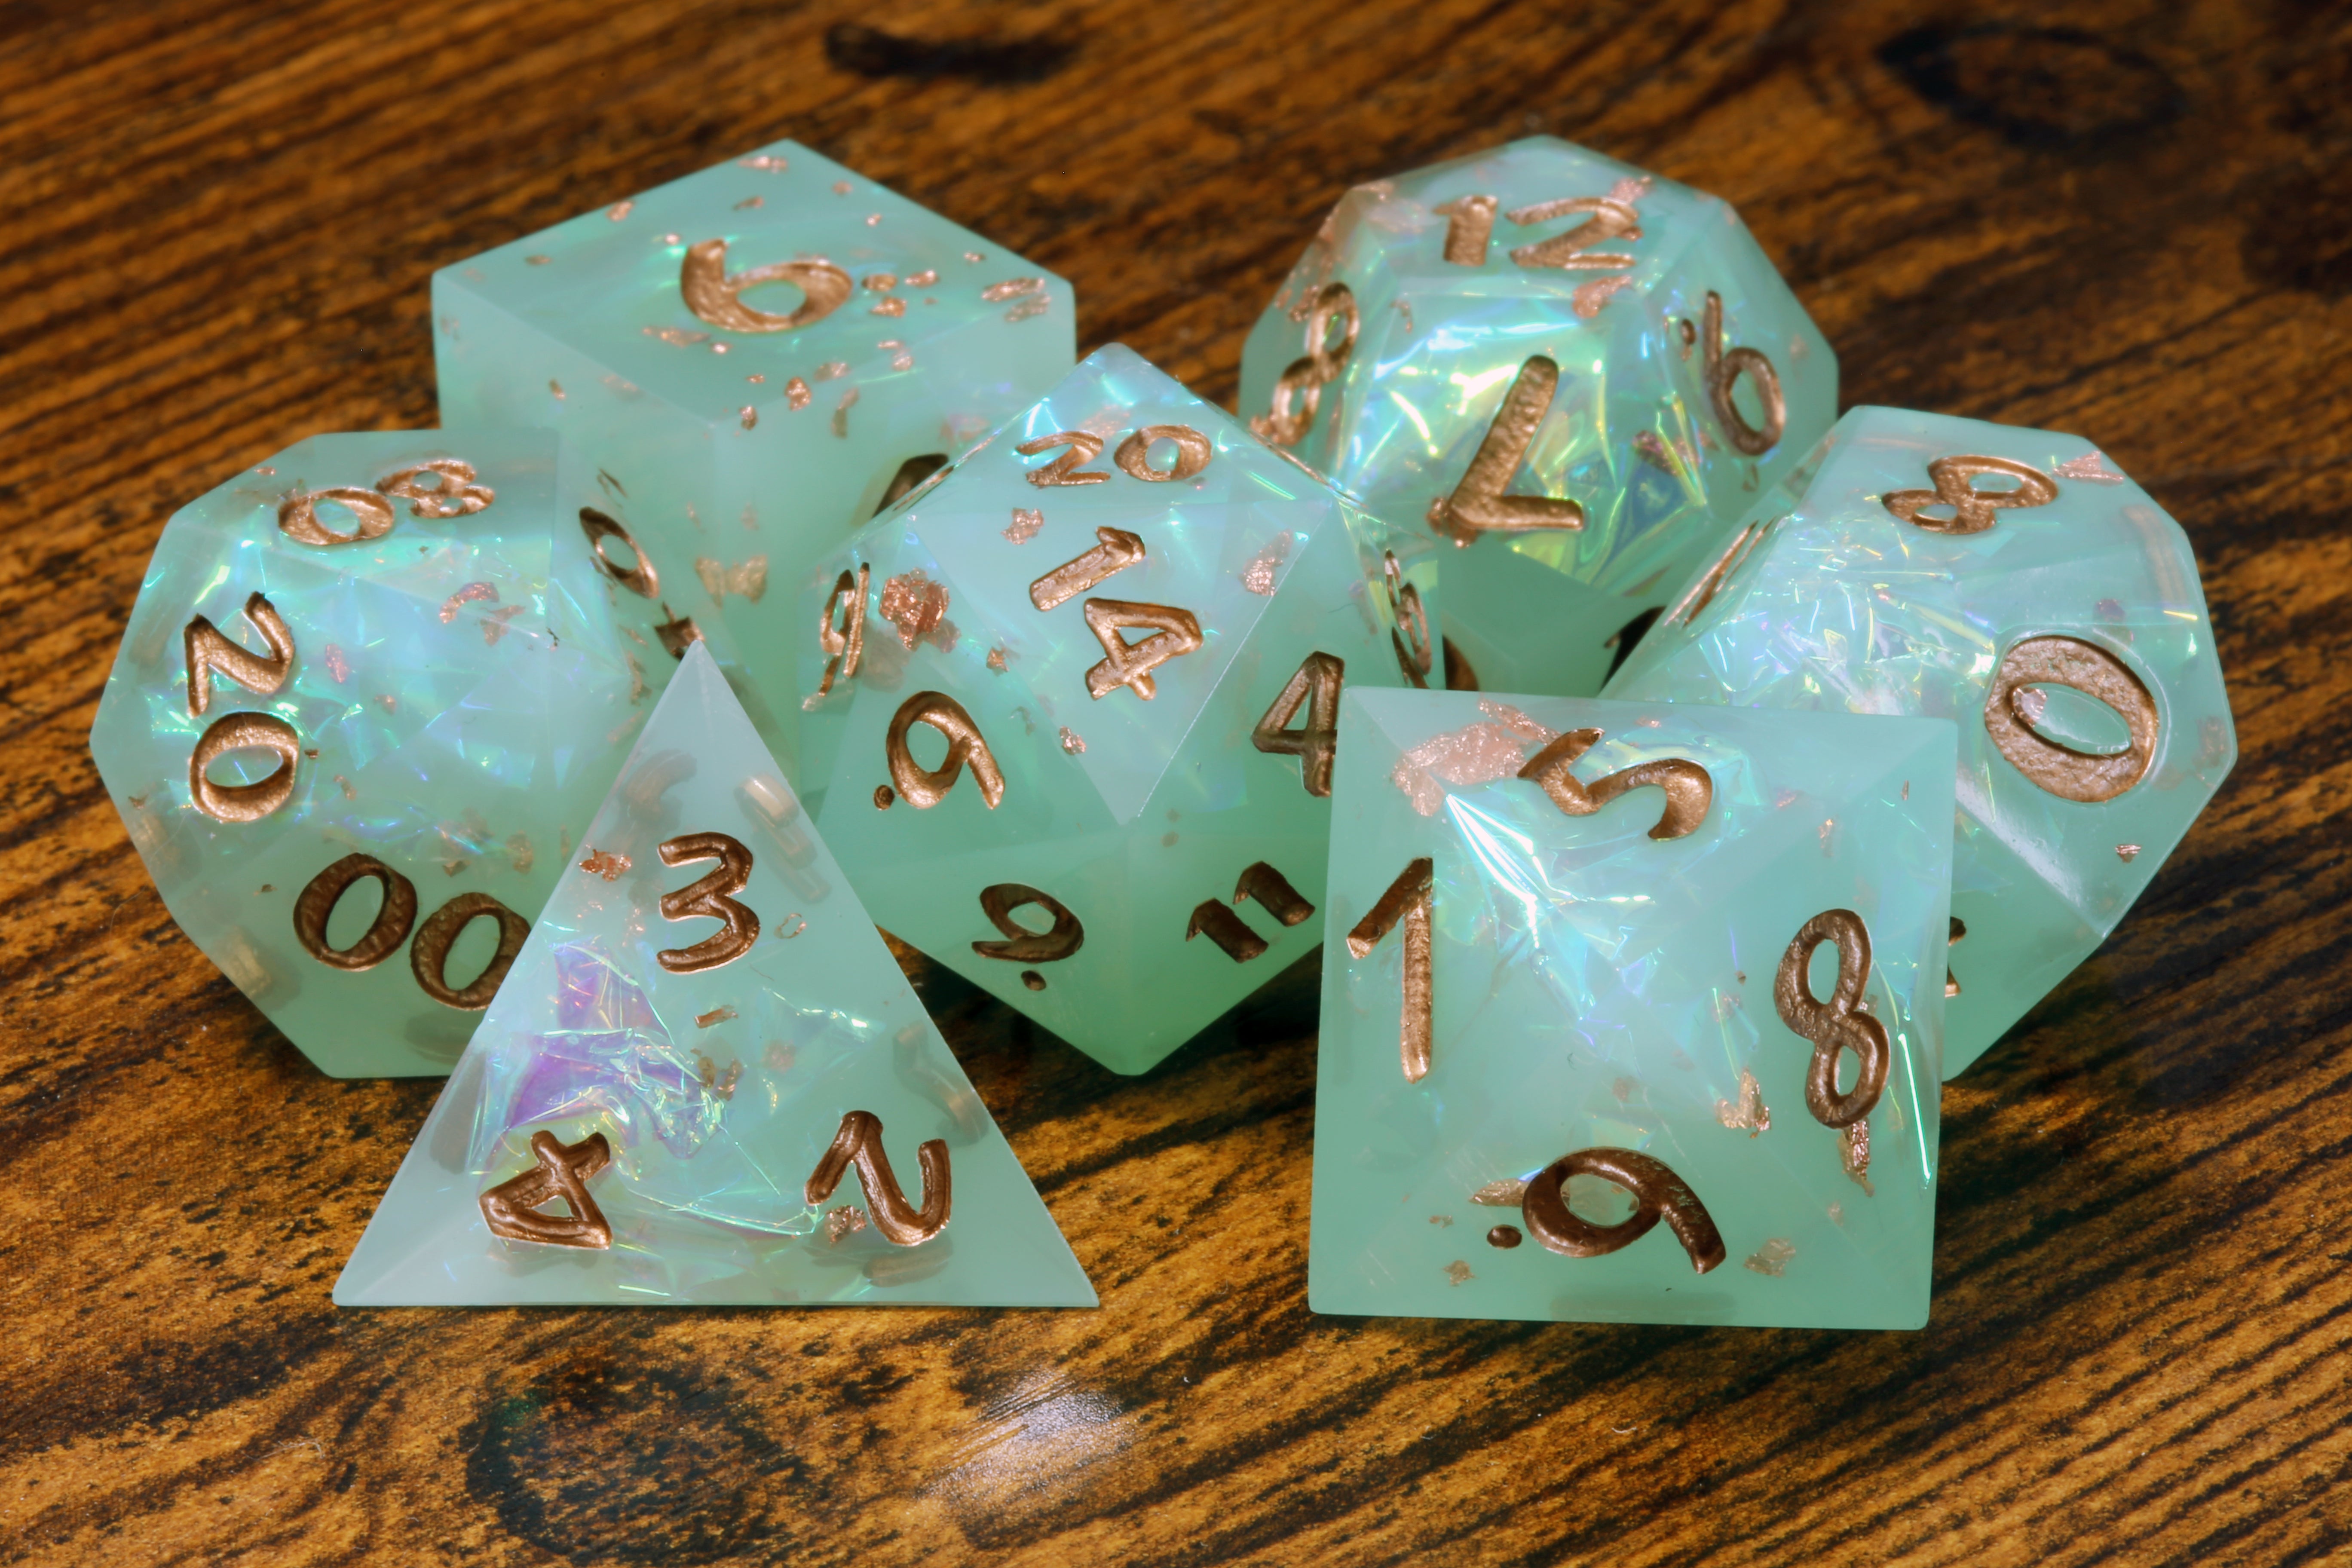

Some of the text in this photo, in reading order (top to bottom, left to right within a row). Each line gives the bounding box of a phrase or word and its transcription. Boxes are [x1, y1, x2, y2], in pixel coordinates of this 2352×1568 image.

[681, 239, 853, 333] 6
[1433, 195, 1638, 269] 12
[1272, 282, 1360, 445] 8
[1016, 425, 1212, 487] 20
[1448, 355, 1583, 531] 7
[1882, 455, 2057, 535] 8
[1030, 526, 1204, 701] 14
[184, 591, 300, 823] 20
[1251, 651, 1344, 797] 4
[1984, 635, 2158, 802] 0
[1517, 727, 1712, 841] 5
[293, 852, 532, 1011] 00
[656, 831, 761, 973] 3
[1186, 861, 1315, 963] 11
[1346, 858, 1433, 1084] 1
[1773, 909, 1890, 1129] 8
[478, 1130, 613, 1250] 4
[805, 1110, 952, 1246] 2
